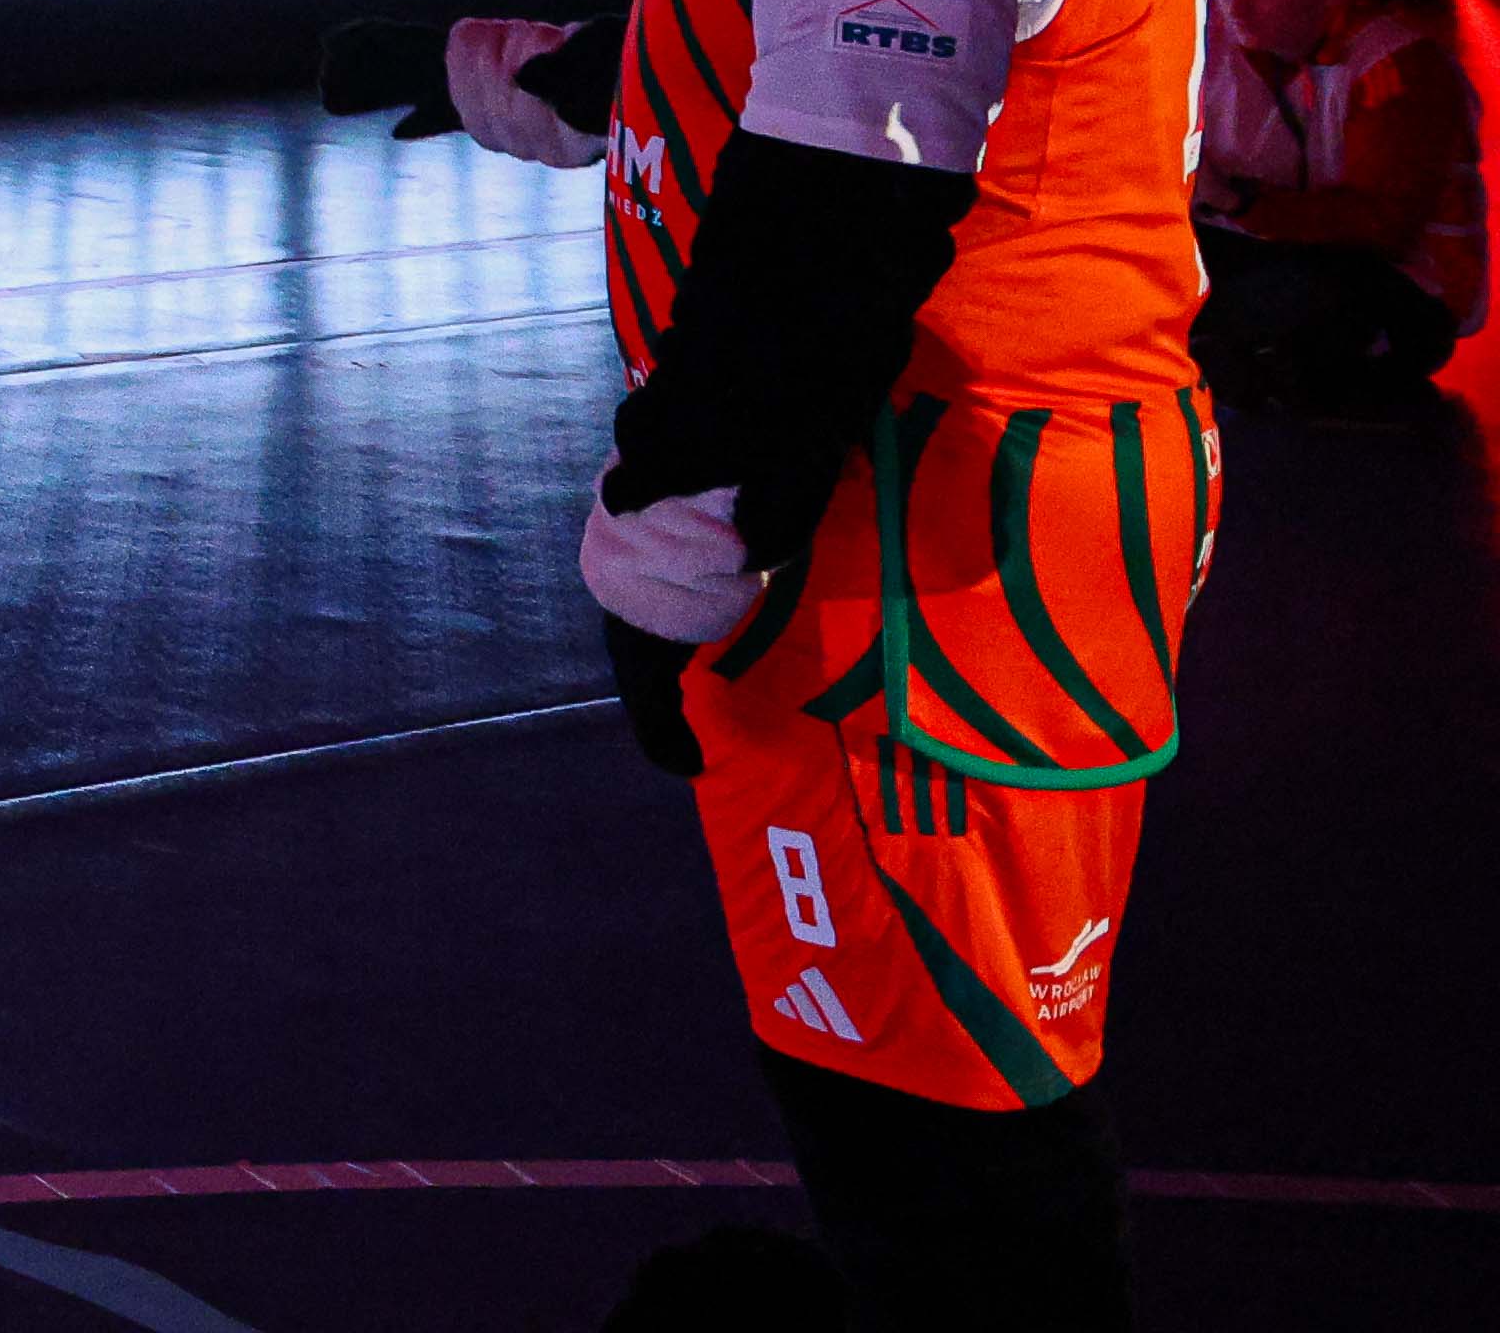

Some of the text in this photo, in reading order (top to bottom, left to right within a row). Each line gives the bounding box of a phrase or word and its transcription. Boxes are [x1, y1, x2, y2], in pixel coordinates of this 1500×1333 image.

[841, 21, 957, 59] RTBS
[608, 119, 665, 194] HM
[767, 826, 836, 948] 8
